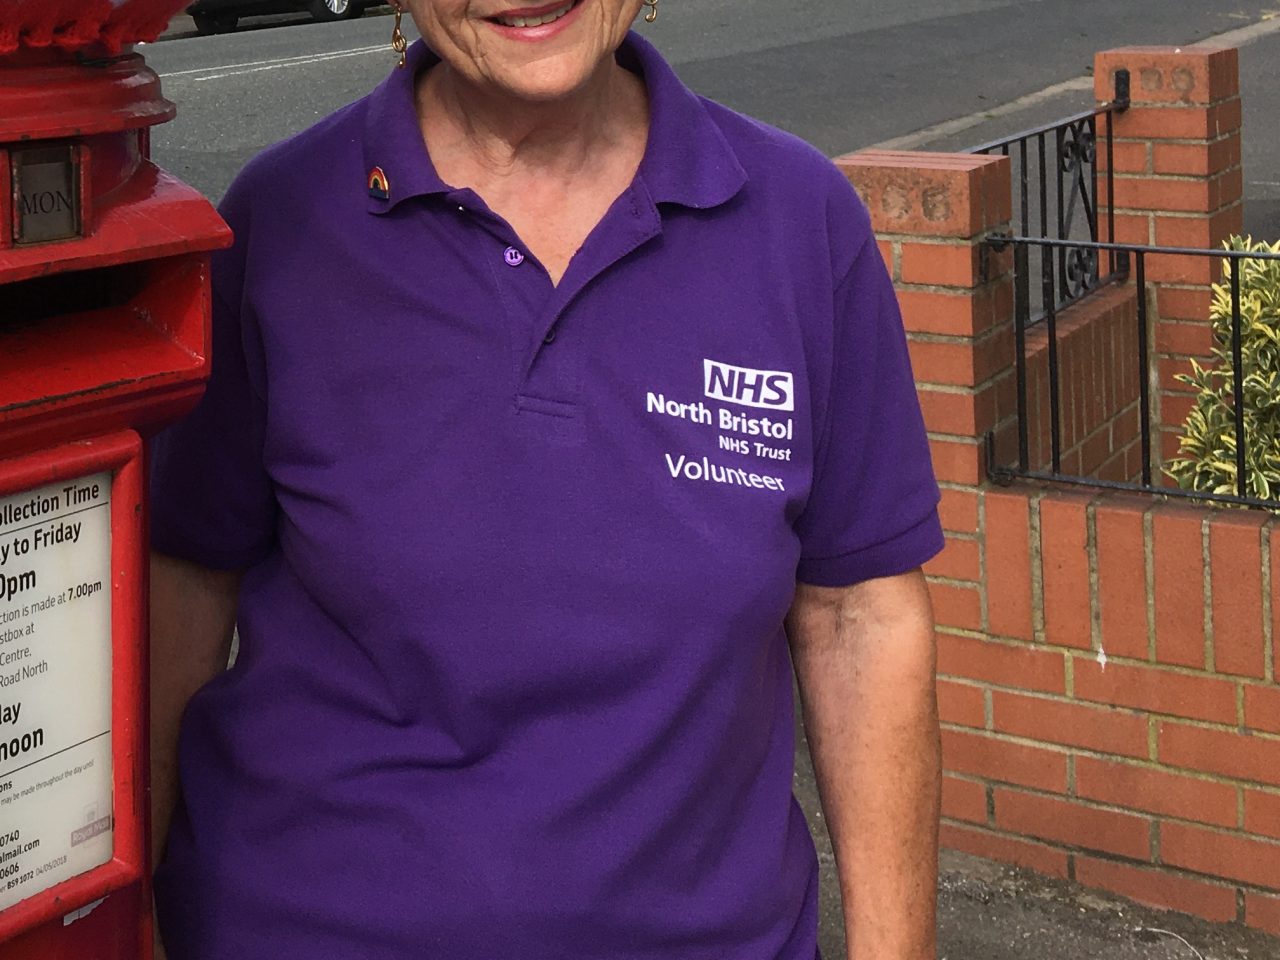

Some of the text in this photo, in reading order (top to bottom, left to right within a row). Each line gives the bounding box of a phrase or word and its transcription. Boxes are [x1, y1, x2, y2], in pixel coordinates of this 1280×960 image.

[21, 189, 71, 217] MON
[707, 364, 789, 406] NHS
[646, 392, 793, 440] North Bristol
[719, 435, 792, 461] NHS Trust
[665, 453, 785, 491] Volunteer
[63, 483, 100, 507] Time
[14, 538, 30, 556] to
[34, 522, 81, 551] Friday
[22, 606, 30, 617] is
[31, 596, 56, 614] made
[57, 592, 66, 606] at
[68, 581, 102, 601] 7.00pm
[25, 622, 35, 636] at
[22, 659, 48, 680] North
[36, 773, 64, 791] throughout
